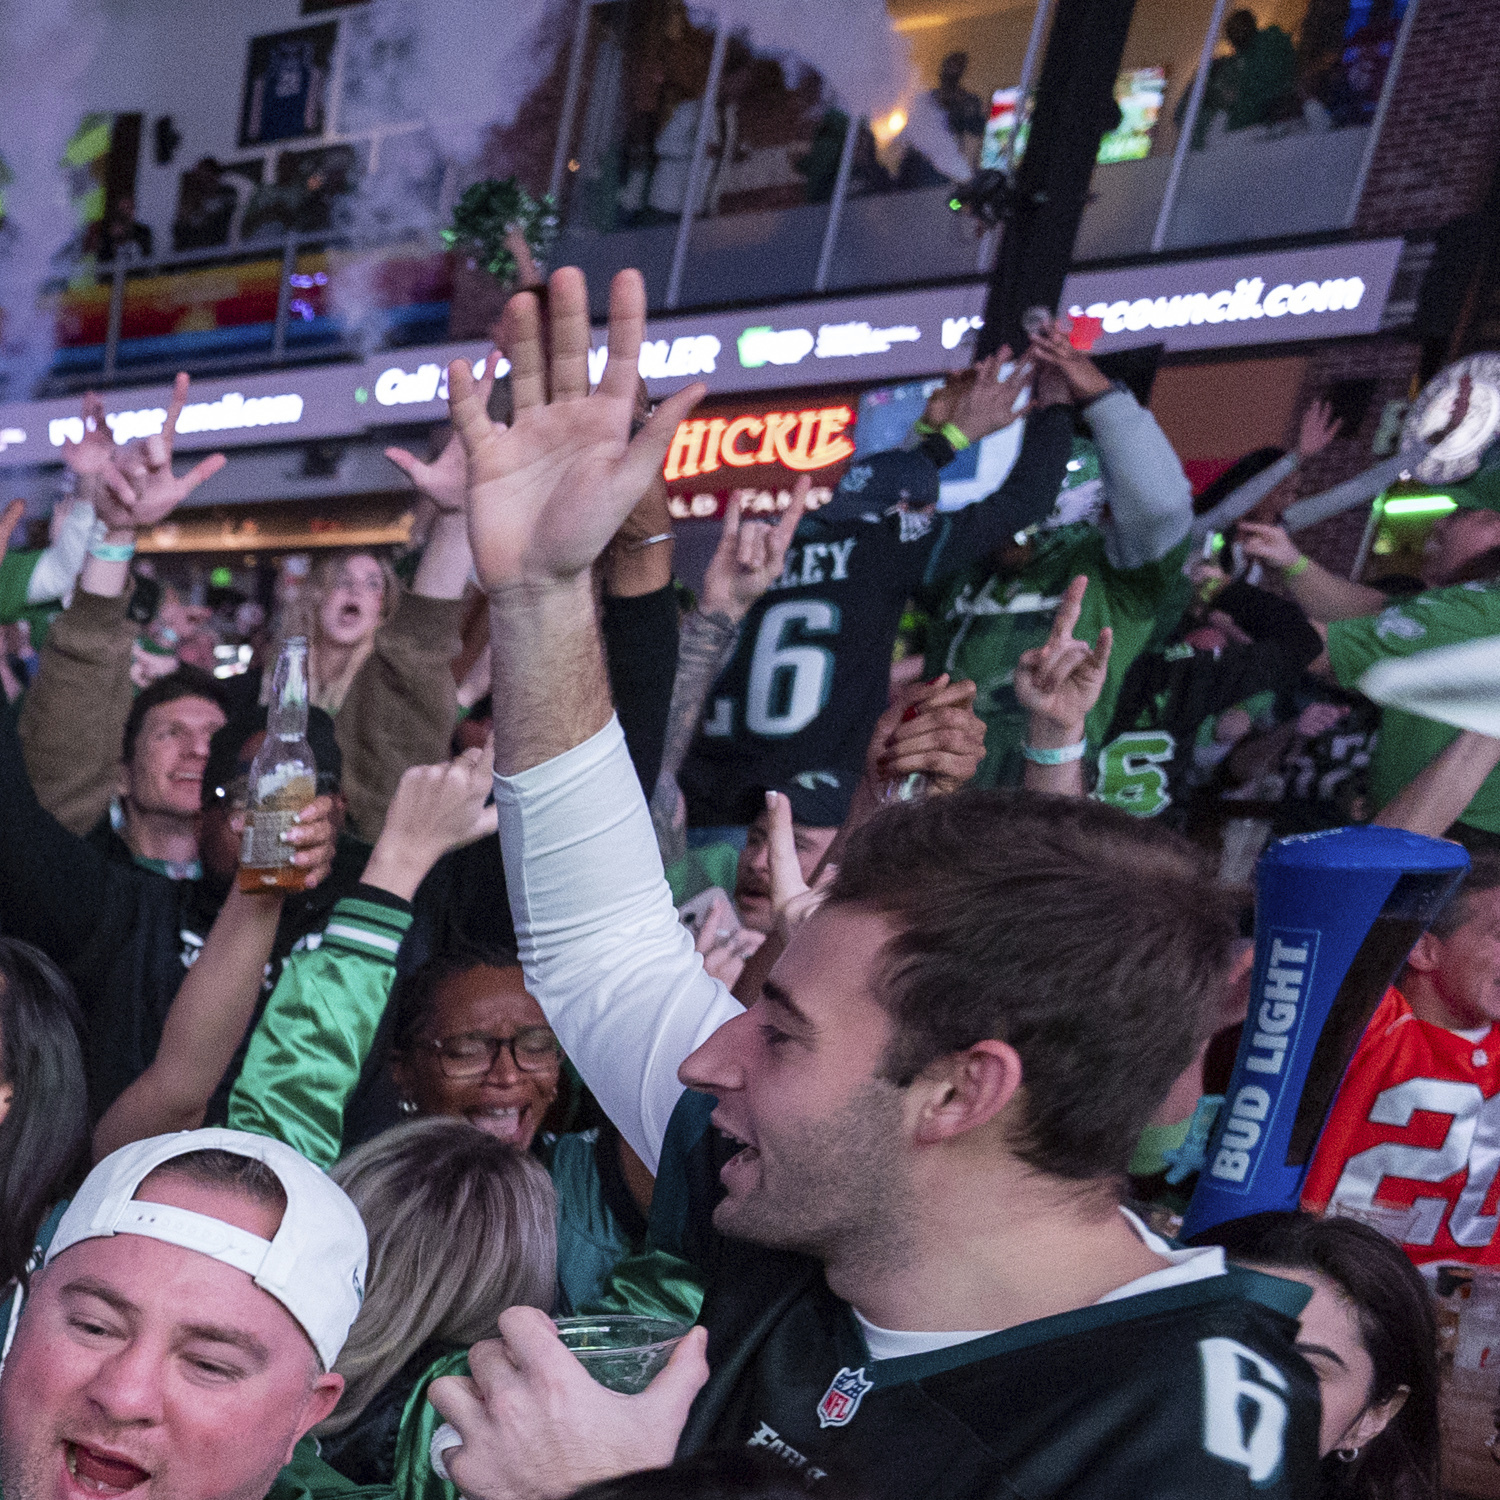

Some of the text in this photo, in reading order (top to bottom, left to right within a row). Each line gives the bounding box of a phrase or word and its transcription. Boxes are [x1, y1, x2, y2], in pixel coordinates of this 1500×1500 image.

[1210, 937, 1314, 1183] BUD LIGHT
[1199, 1335, 1291, 1483] 6
